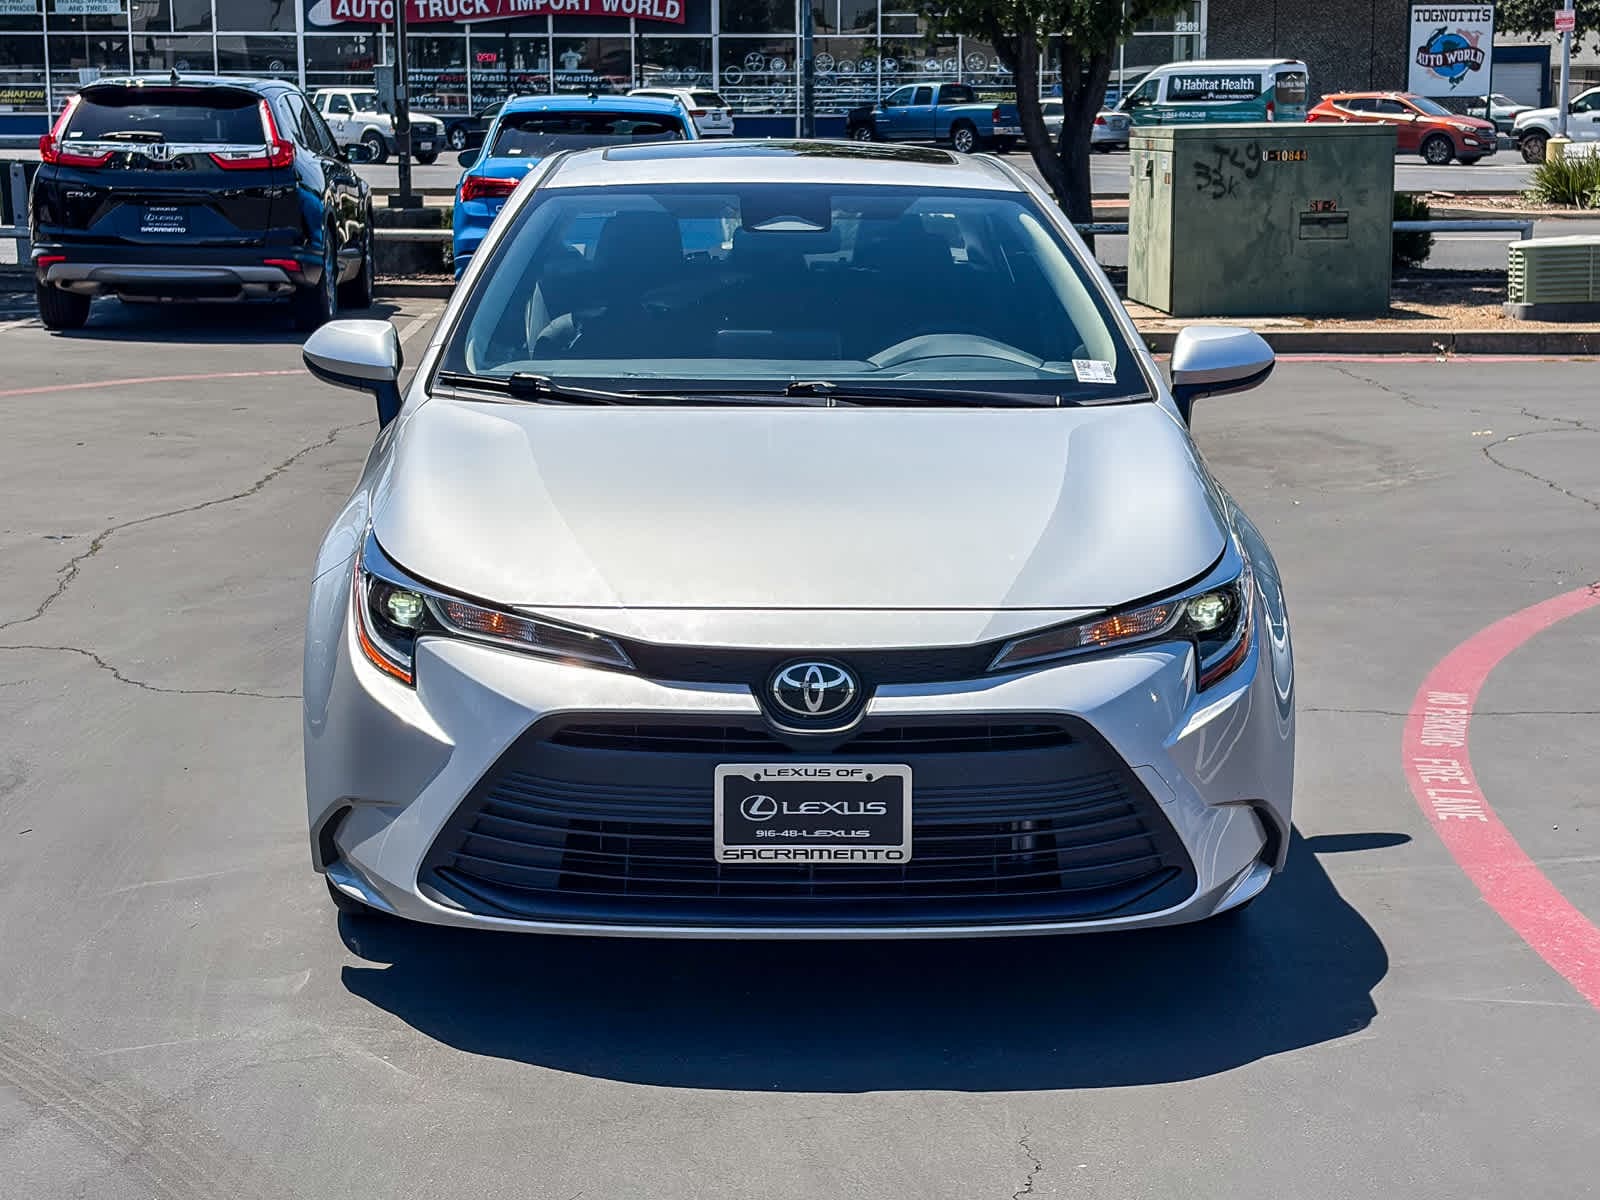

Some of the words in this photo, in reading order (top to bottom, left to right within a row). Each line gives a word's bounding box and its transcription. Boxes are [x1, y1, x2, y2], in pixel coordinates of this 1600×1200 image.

[336, 0, 394, 19] AUTO
[414, 0, 490, 18] TRUCK
[510, 0, 592, 12] IMPORT
[602, 0, 681, 19] WORLD
[1414, 7, 1491, 22] TOGNOTTI'S
[1418, 53, 1444, 67] AUTO
[1446, 49, 1483, 65] WORLD
[1183, 78, 1220, 90] Habitat
[1220, 78, 1255, 90] Health
[1427, 691, 1470, 704] NO
[1420, 707, 1470, 747] PARKING
[764, 768, 831, 776] LEXUS
[836, 768, 864, 776] OF
[1412, 757, 1471, 785] FIRE
[782, 802, 888, 815] LEXUS
[1425, 788, 1488, 822] LANE
[756, 830, 870, 838] 916-48-LEXUS
[722, 848, 904, 860] SACRAMENTO
